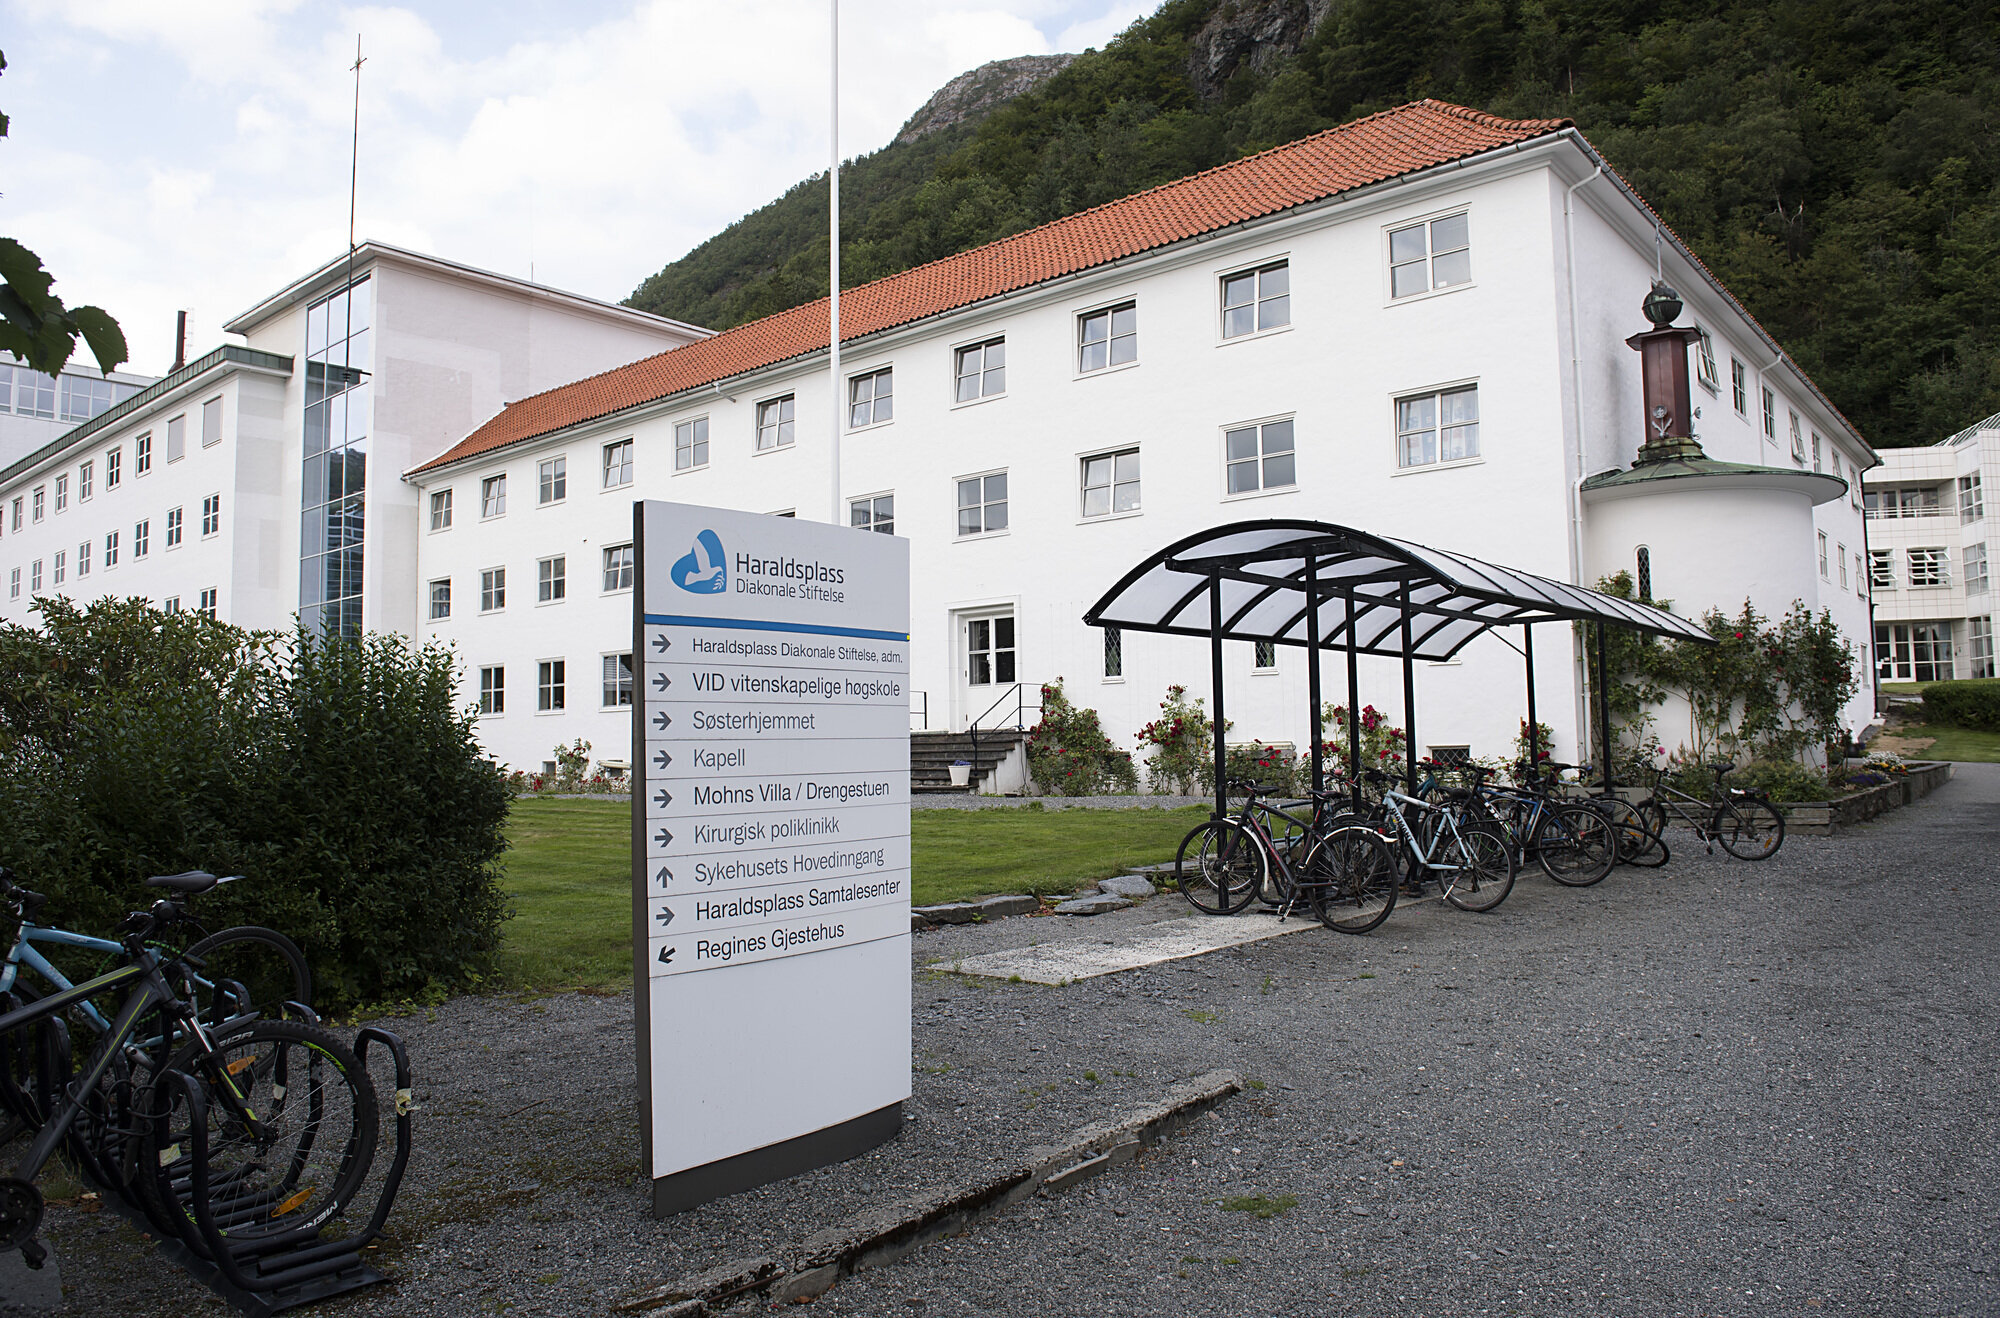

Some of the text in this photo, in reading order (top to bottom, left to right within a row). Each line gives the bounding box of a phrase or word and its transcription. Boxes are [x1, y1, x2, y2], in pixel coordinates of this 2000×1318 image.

[736, 553, 844, 584] Haraldsplass
[737, 578, 844, 603] Diakonale Stiftelse
[693, 638, 903, 664] Haraldsplass Diakonale Stiftelse, adm.
[692, 673, 900, 699] VID vitenskapelige høgskole
[693, 711, 815, 733] Søsterhjemmet
[694, 748, 745, 771] Kapell
[695, 781, 889, 805] Mohns Villa / Drengestuen
[695, 816, 839, 845] Kirurgisk poliklinikk
[695, 848, 884, 886] Sykehusets Hovedinngang
[697, 880, 900, 920] Haraldsplass Samtalesenter
[697, 923, 844, 960] Regines Gjestehus
